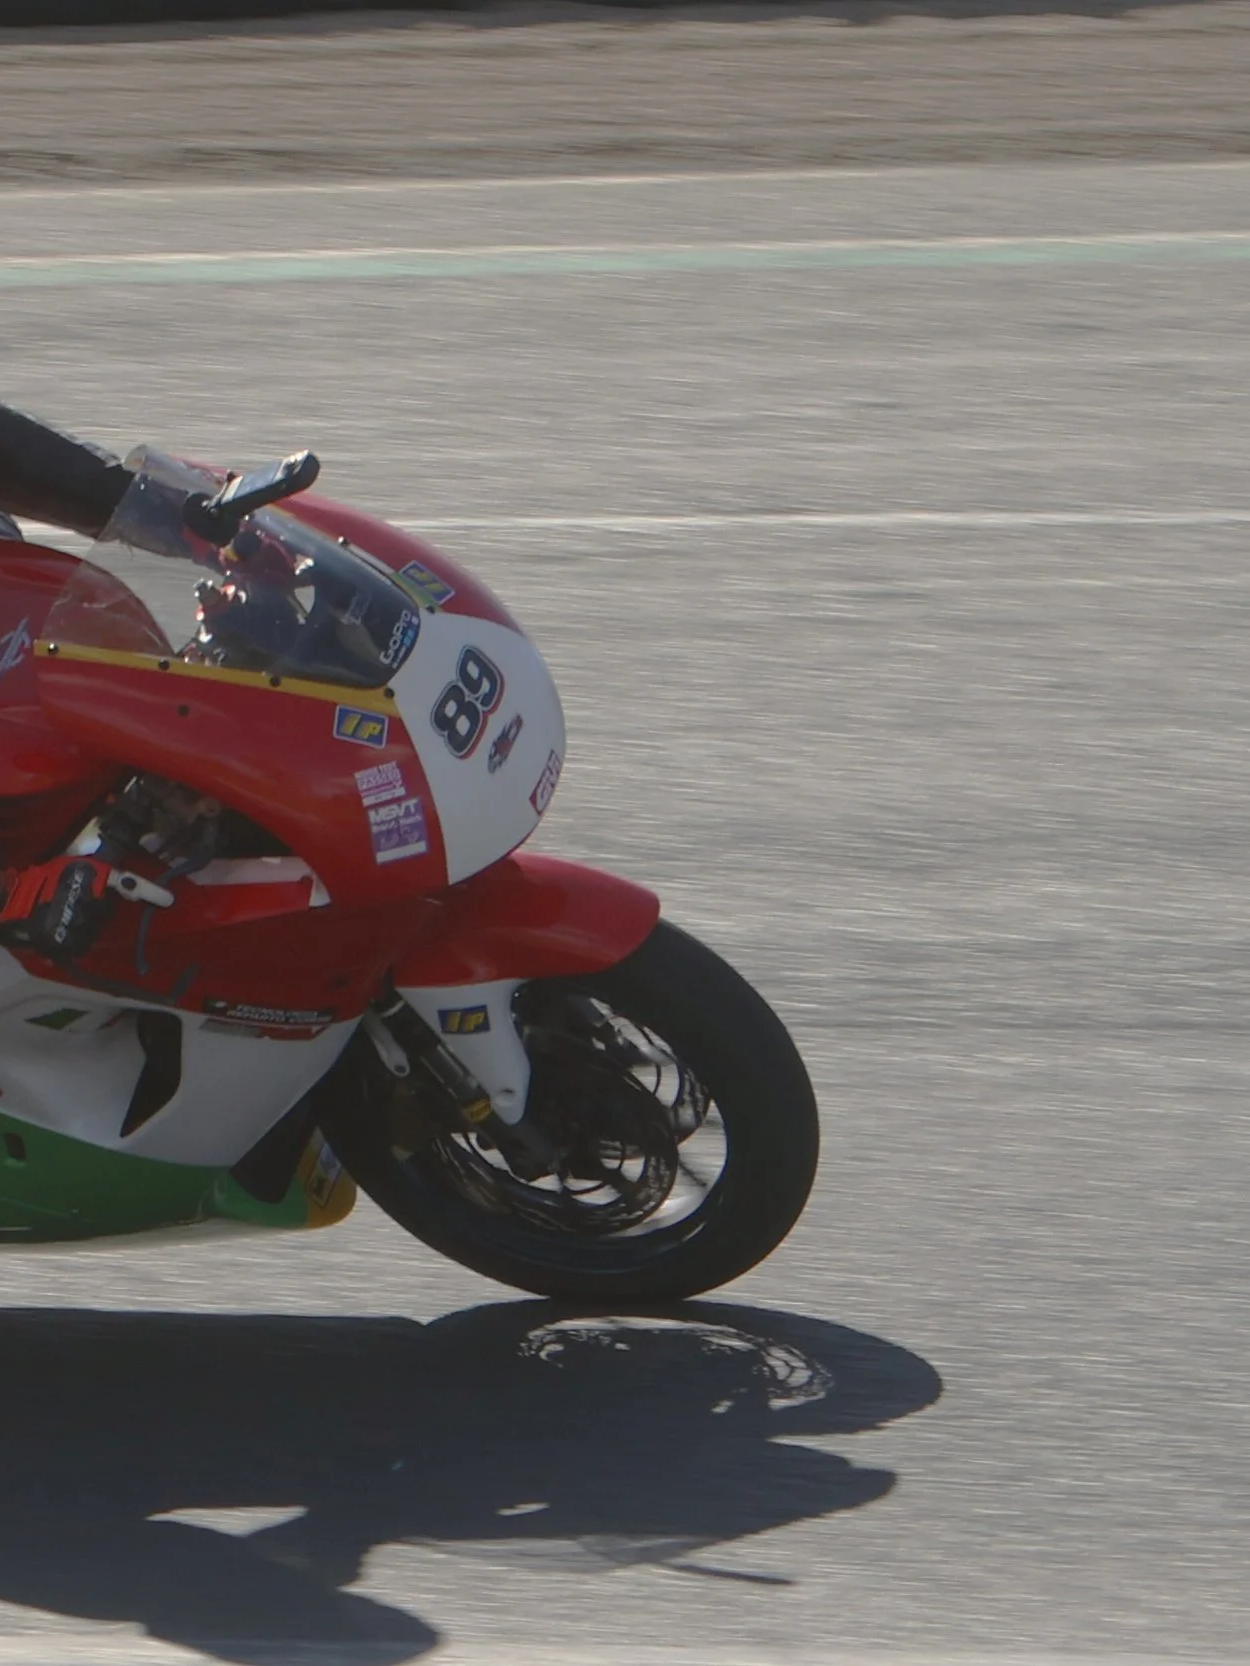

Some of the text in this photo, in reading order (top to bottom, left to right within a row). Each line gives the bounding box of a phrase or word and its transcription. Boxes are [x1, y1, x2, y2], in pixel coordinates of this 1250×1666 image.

[379, 610, 411, 665] GoPro
[430, 644, 505, 760] 89
[369, 799, 419, 825] MSVT
